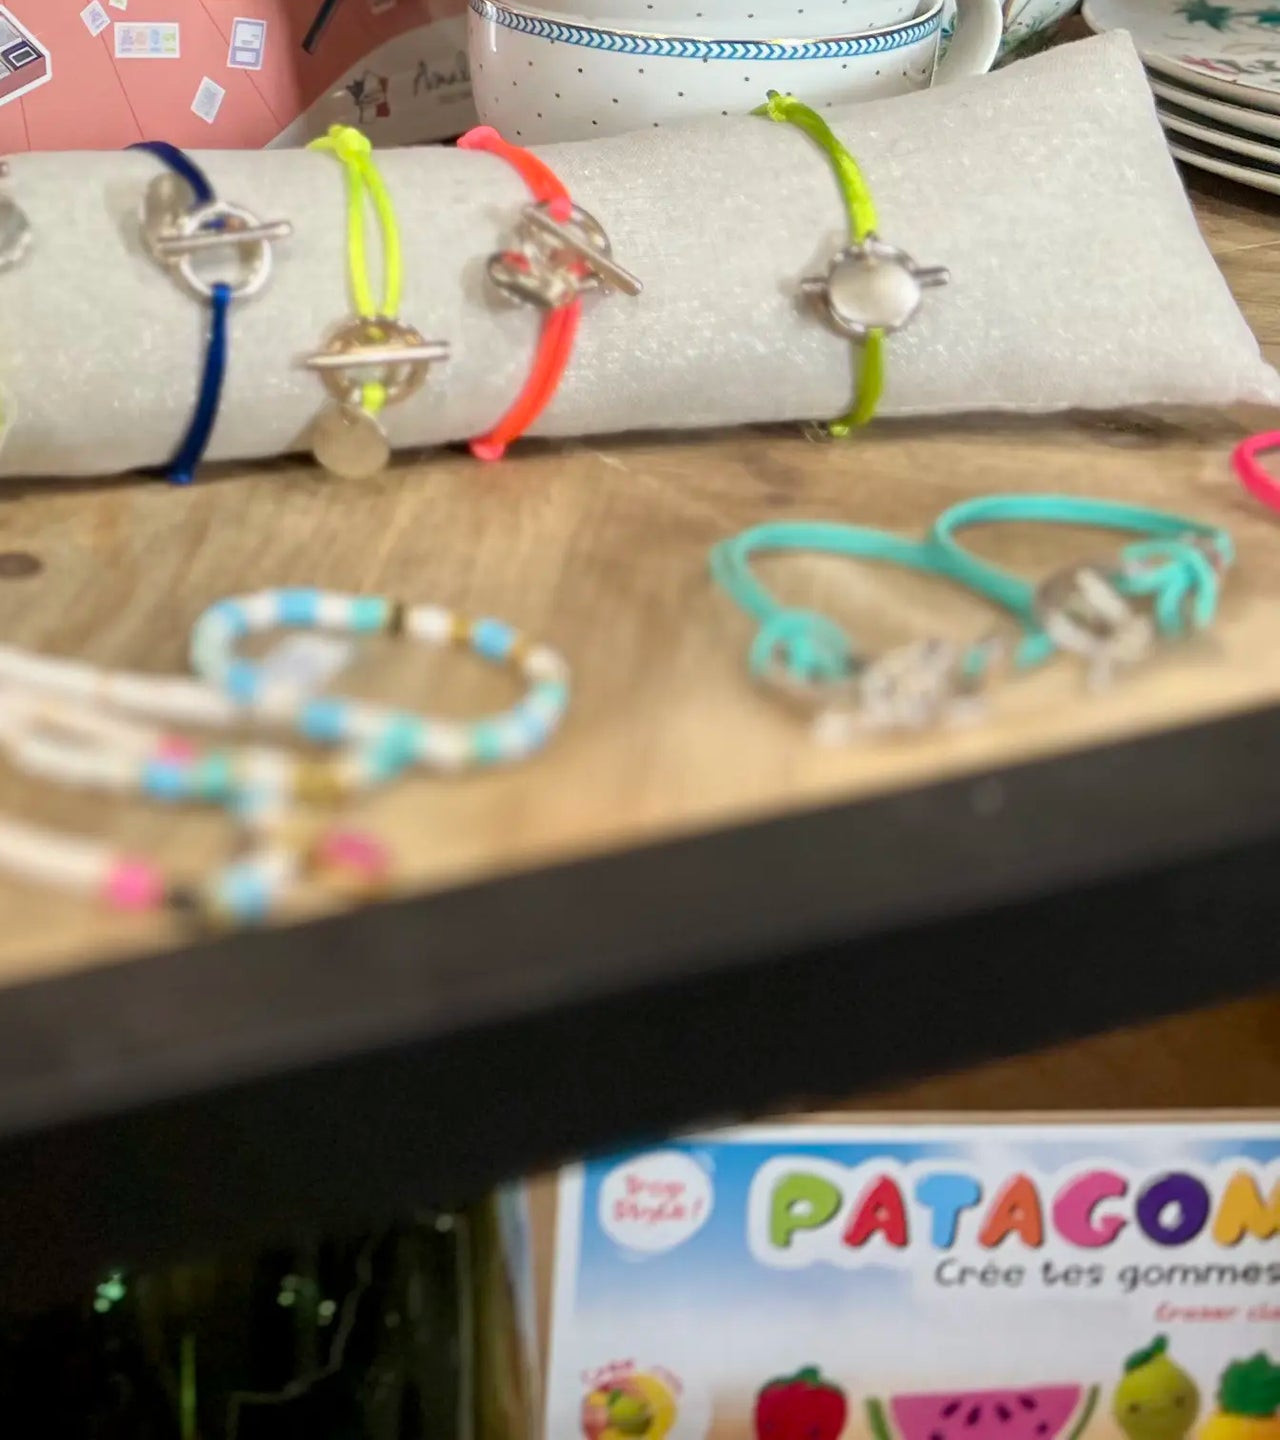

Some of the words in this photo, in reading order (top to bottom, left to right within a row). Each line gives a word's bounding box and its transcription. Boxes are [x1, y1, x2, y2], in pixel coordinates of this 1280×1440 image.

[934, 1257, 1025, 1287] Crée
[1042, 1261, 1104, 1287] tes
[1117, 1262, 1280, 1293] gommes
